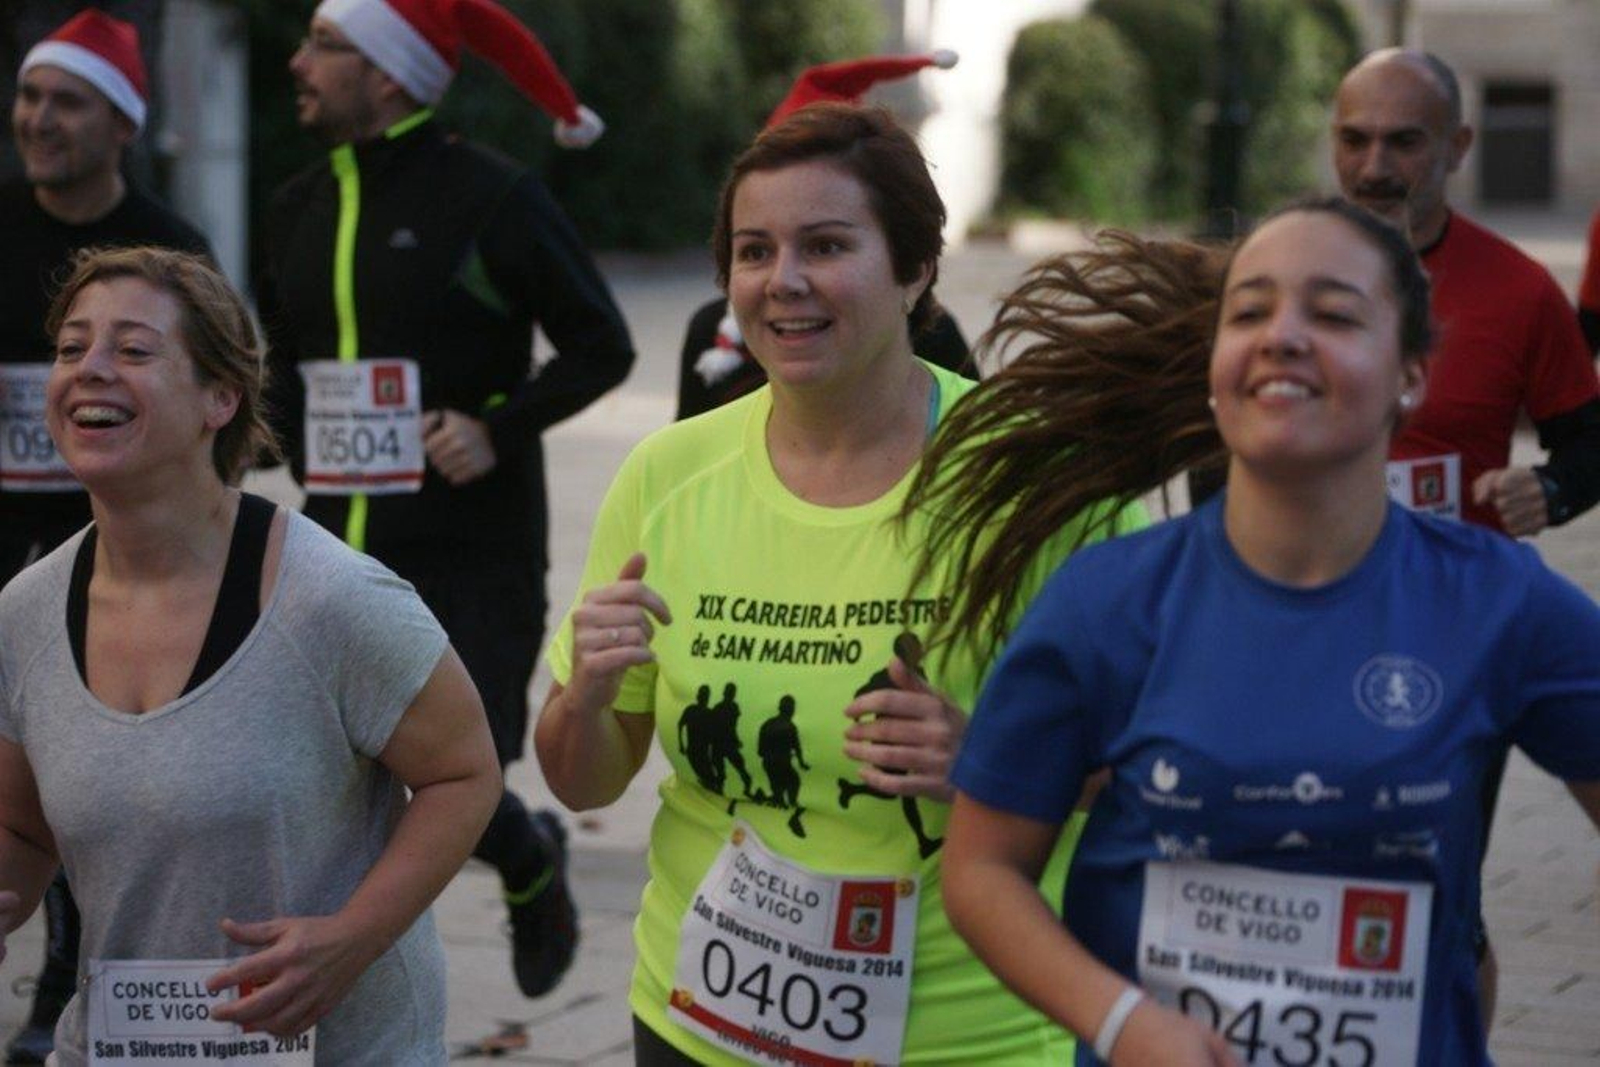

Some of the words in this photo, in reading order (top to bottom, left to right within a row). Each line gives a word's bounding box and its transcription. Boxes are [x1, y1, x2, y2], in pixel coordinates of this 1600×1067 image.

[316, 424, 400, 465] 0504
[696, 594, 727, 620] XIX
[731, 598, 836, 628] CARREIRA
[843, 598, 951, 626] PEDESTRE
[690, 632, 709, 658] de
[713, 633, 755, 662] SAN
[759, 634, 862, 665] MARTIÑO
[734, 851, 820, 908] CONCELLO
[729, 877, 747, 903] DE
[755, 896, 804, 925] VIGO
[1181, 881, 1321, 922] CONCELLO
[693, 894, 715, 922] San
[716, 911, 783, 954] Silvestre
[787, 942, 857, 974] Viguesa
[861, 957, 904, 978] 2014
[1195, 910, 1228, 934] DE
[1238, 919, 1302, 945] VIGO
[112, 982, 220, 999] CONCELLO
[702, 939, 869, 1042] 0403
[1146, 944, 1182, 969] San
[1189, 952, 1277, 984] Silvestre
[1282, 969, 1365, 998] Viguesa
[1370, 977, 1417, 1001] 2014
[127, 1004, 154, 1021] DE
[161, 1004, 210, 1021] VIGO
[95, 1040, 125, 1059] San
[129, 1040, 197, 1059] Silvestre
[202, 1039, 270, 1060] Viguesa
[275, 1036, 309, 1052] 2014
